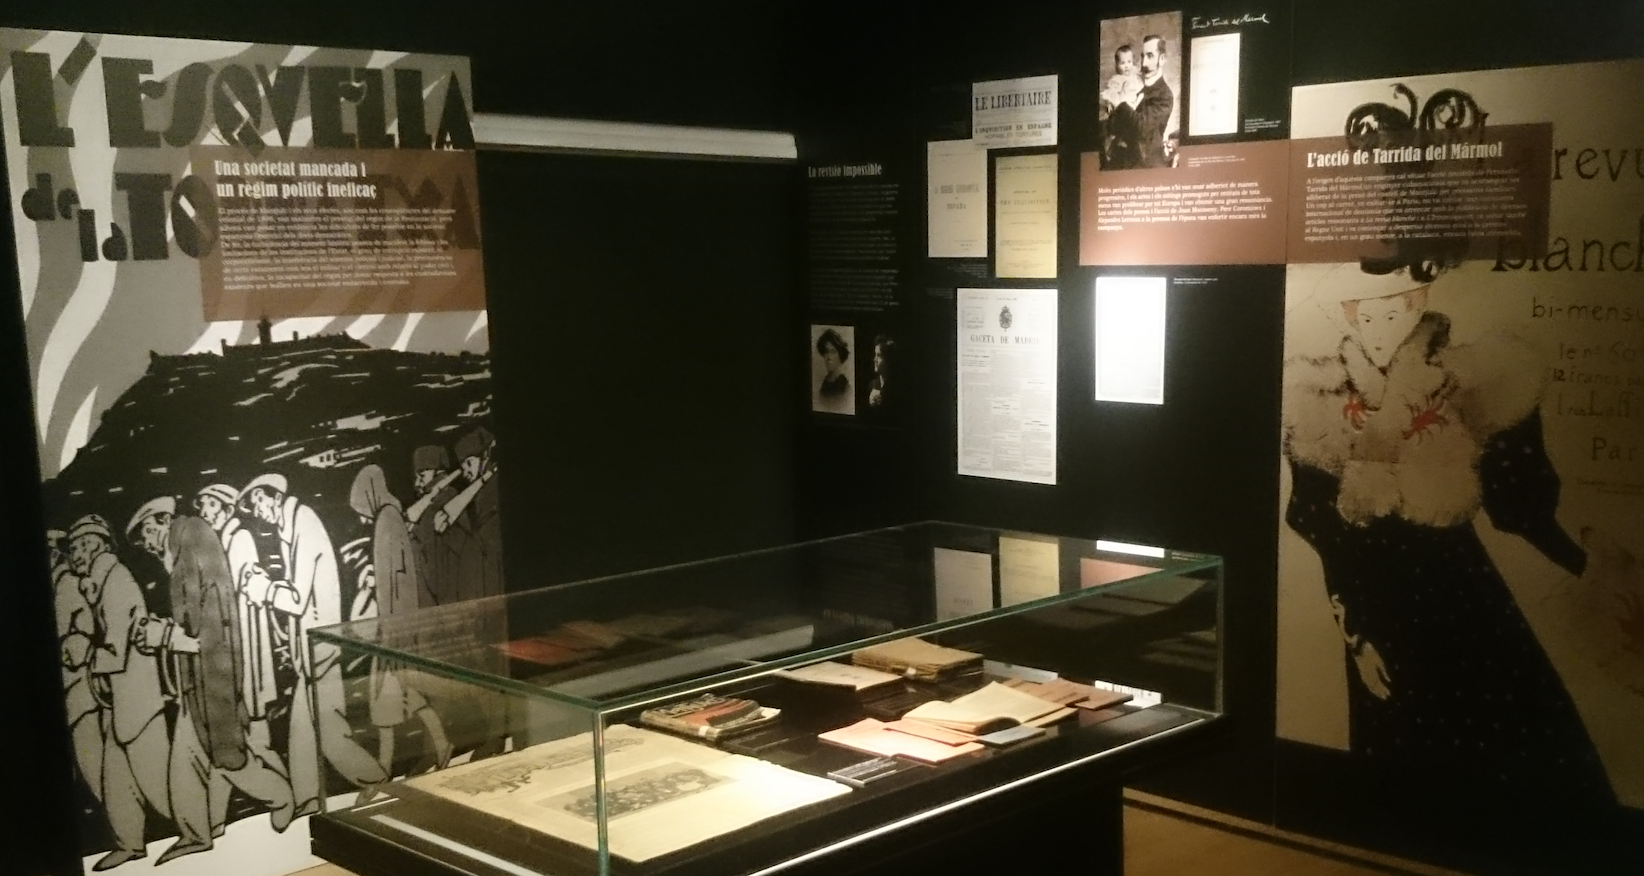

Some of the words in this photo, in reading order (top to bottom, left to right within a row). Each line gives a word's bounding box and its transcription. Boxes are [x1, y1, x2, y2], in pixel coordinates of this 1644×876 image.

[974, 97, 988, 112] LE
[991, 91, 1052, 109] LIBERTAIRE
[1307, 150, 1350, 168] L'acció
[1353, 150, 1368, 165] de
[1373, 146, 1422, 164] Tarrida
[1426, 144, 1446, 160] del
[1451, 142, 1502, 160] Mármol
[214, 160, 240, 176] Una
[244, 161, 296, 176] societat
[300, 162, 358, 177] mancada
[361, 162, 366, 177] i
[808, 166, 816, 178] La
[844, 163, 882, 178] impossible
[216, 184, 234, 197] un
[238, 180, 278, 199] règim
[327, 182, 377, 200] ineficaç
[970, 335, 994, 344] GACETA
[1000, 336, 1009, 344] DE
